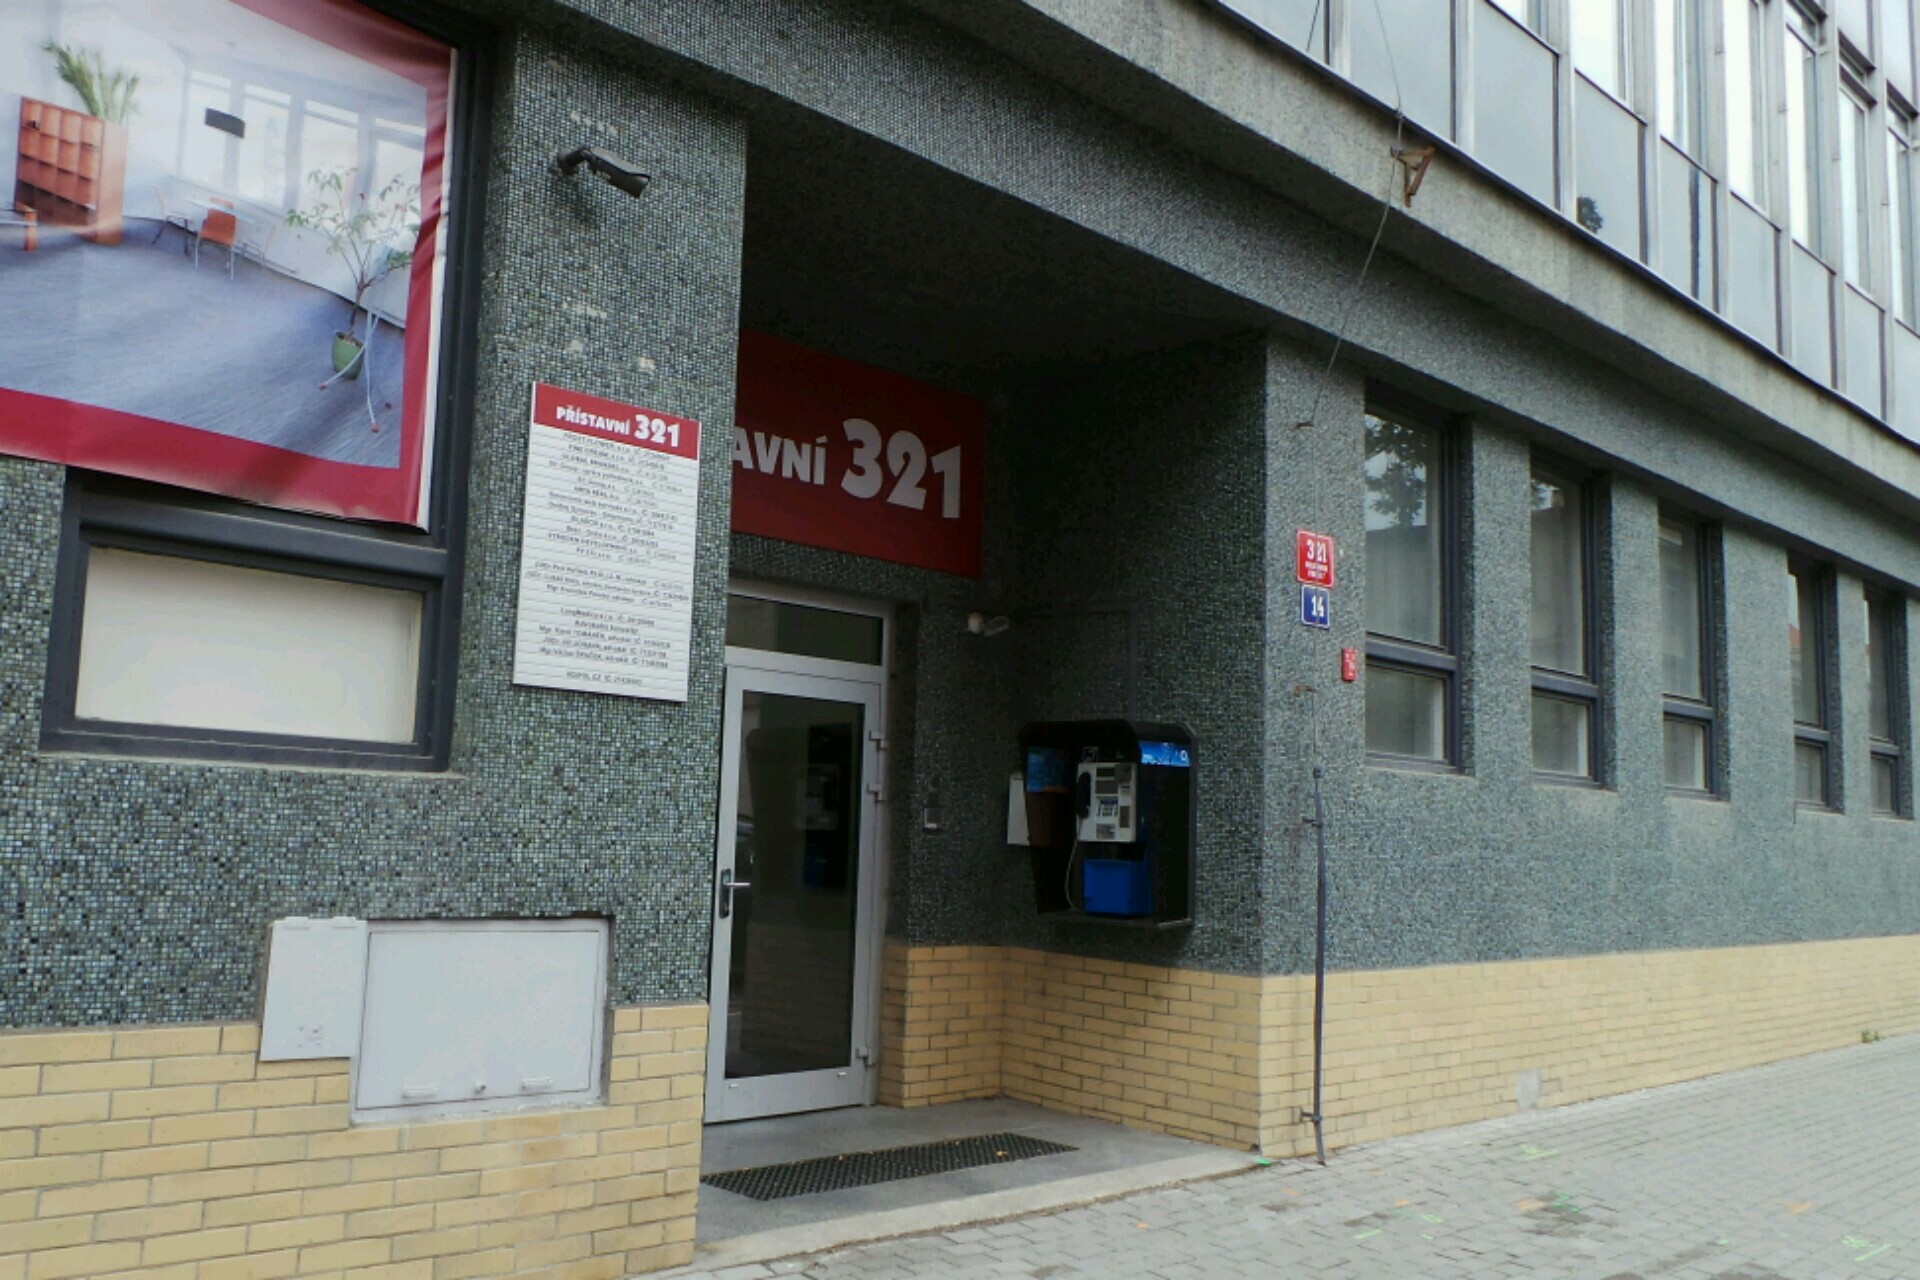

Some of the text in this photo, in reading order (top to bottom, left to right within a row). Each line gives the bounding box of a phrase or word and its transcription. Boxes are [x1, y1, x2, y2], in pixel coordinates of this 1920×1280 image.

[556, 404, 680, 448] PŘÍSTAVNÍ 321
[841, 418, 961, 518] 321
[1307, 539, 1327, 563] 321
[1311, 595, 1325, 618] 14
